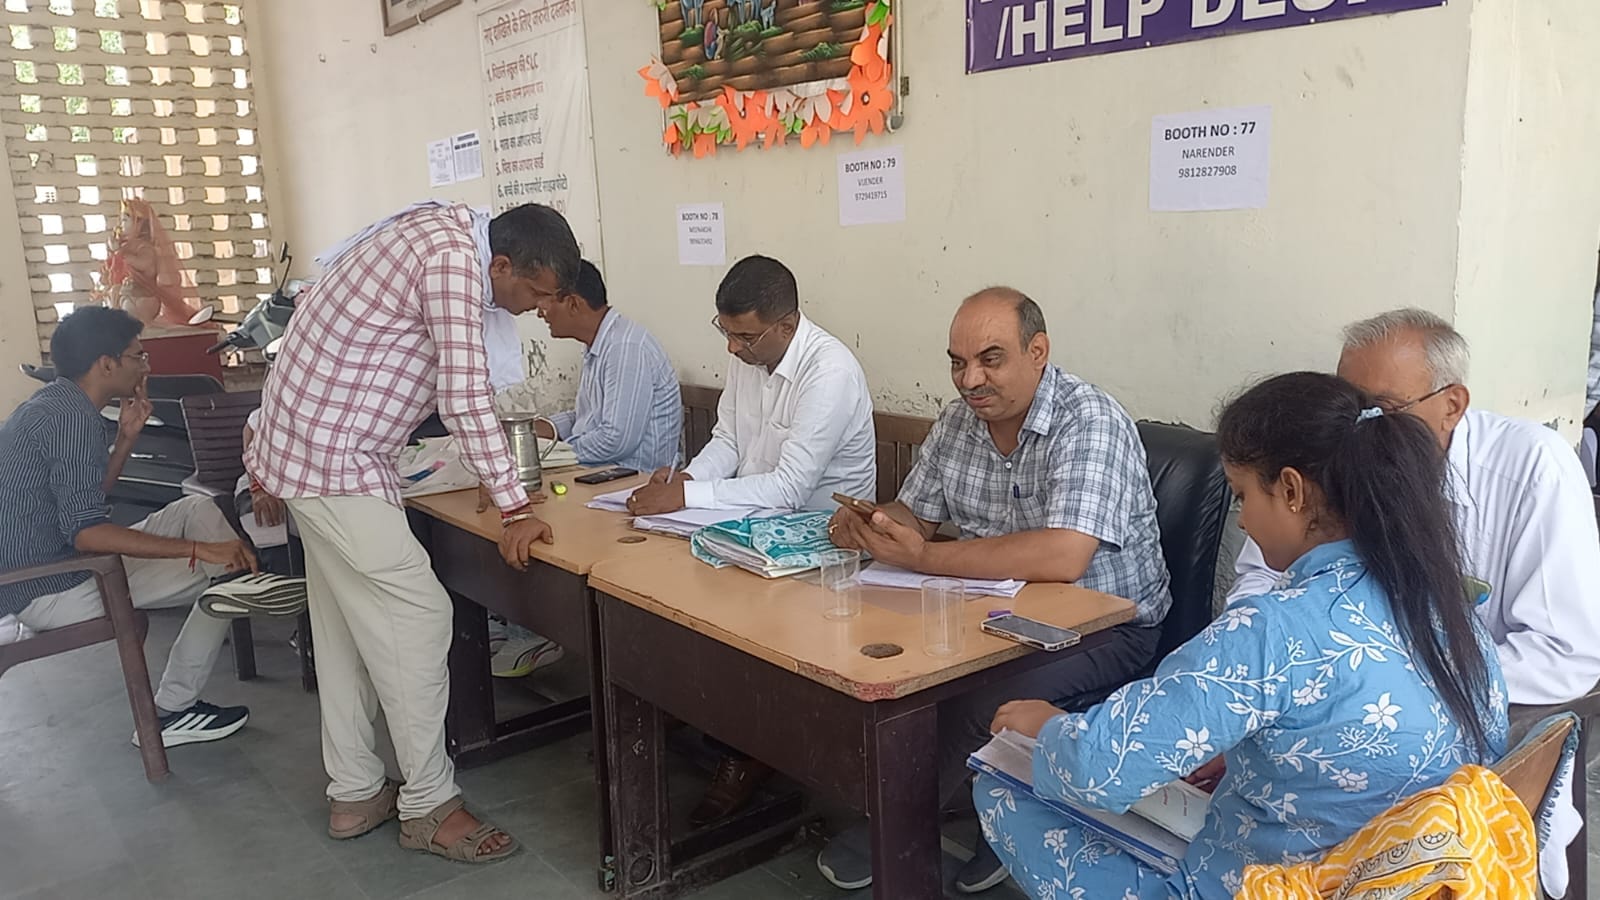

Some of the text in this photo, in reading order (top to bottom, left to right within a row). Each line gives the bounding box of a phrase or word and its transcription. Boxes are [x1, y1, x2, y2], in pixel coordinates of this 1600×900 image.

[1164, 125, 1207, 141] BOOTH
[1210, 124, 1230, 137] NO
[1240, 121, 1256, 135] 77
[1182, 145, 1235, 159] NARENDER
[845, 161, 869, 173] BOOTH
[870, 160, 881, 170] NO
[887, 157, 896, 168] 79
[1178, 165, 1237, 178] 9812827908
